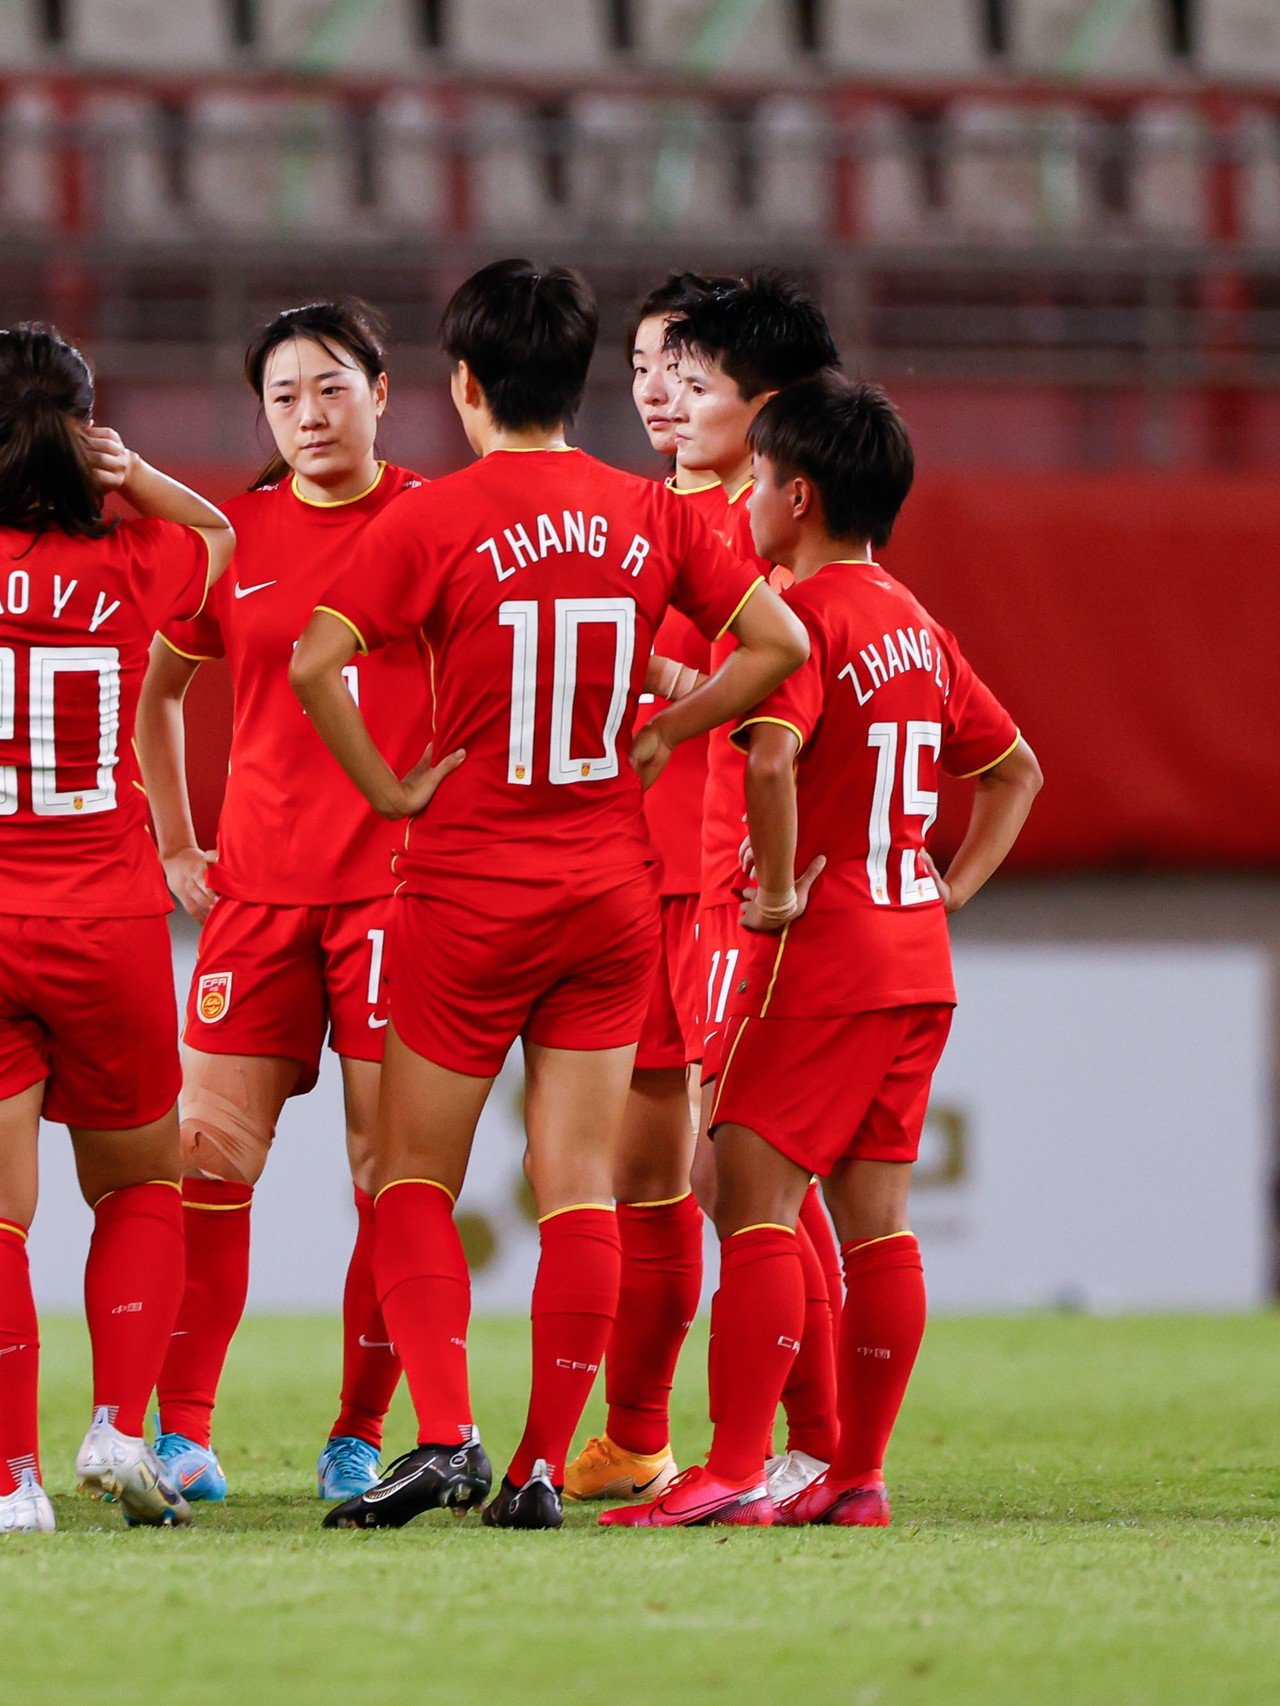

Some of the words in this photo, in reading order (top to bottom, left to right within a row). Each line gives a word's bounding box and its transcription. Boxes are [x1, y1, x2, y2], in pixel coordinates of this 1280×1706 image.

[475, 510, 608, 582] ZHANG
[620, 534, 650, 577] R
[52, 574, 78, 618] Y
[498, 597, 636, 786] 10
[837, 627, 933, 707] ZHANG
[203, 978, 227, 989] CFA
[704, 948, 740, 1023] 11
